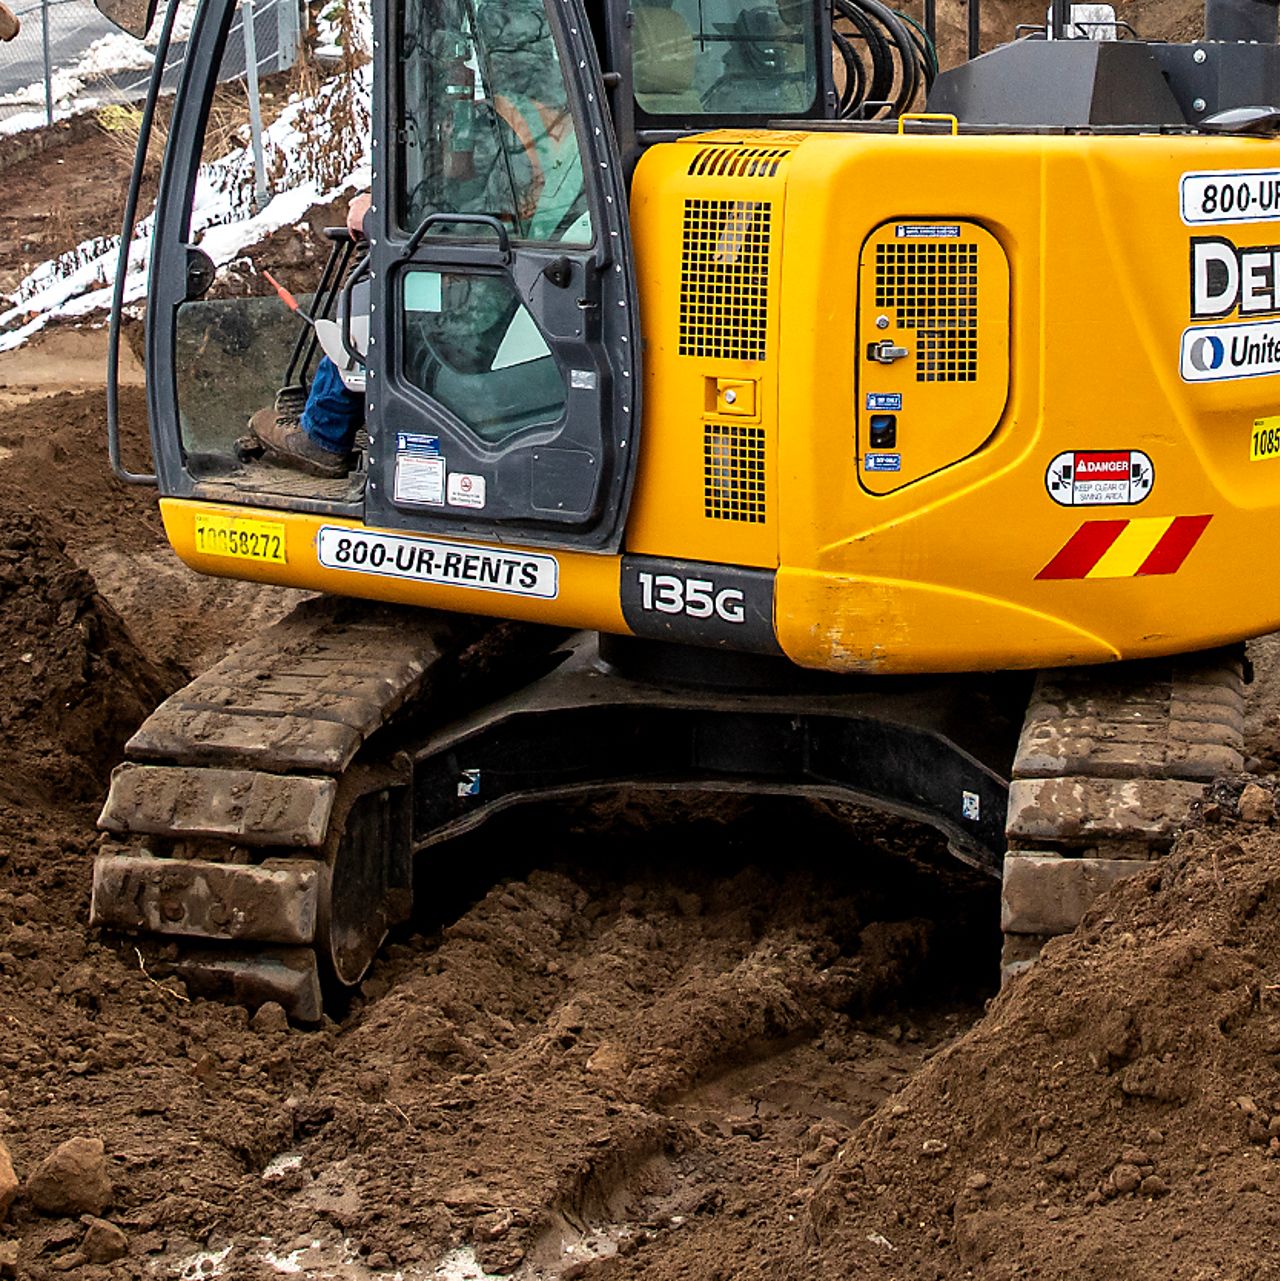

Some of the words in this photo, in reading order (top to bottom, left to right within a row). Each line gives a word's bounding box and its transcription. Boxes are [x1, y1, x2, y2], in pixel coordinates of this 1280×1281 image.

[1087, 461, 1129, 472] DANGER
[335, 538, 539, 588] 800-UR-RENTS
[639, 572, 745, 622] 135G
